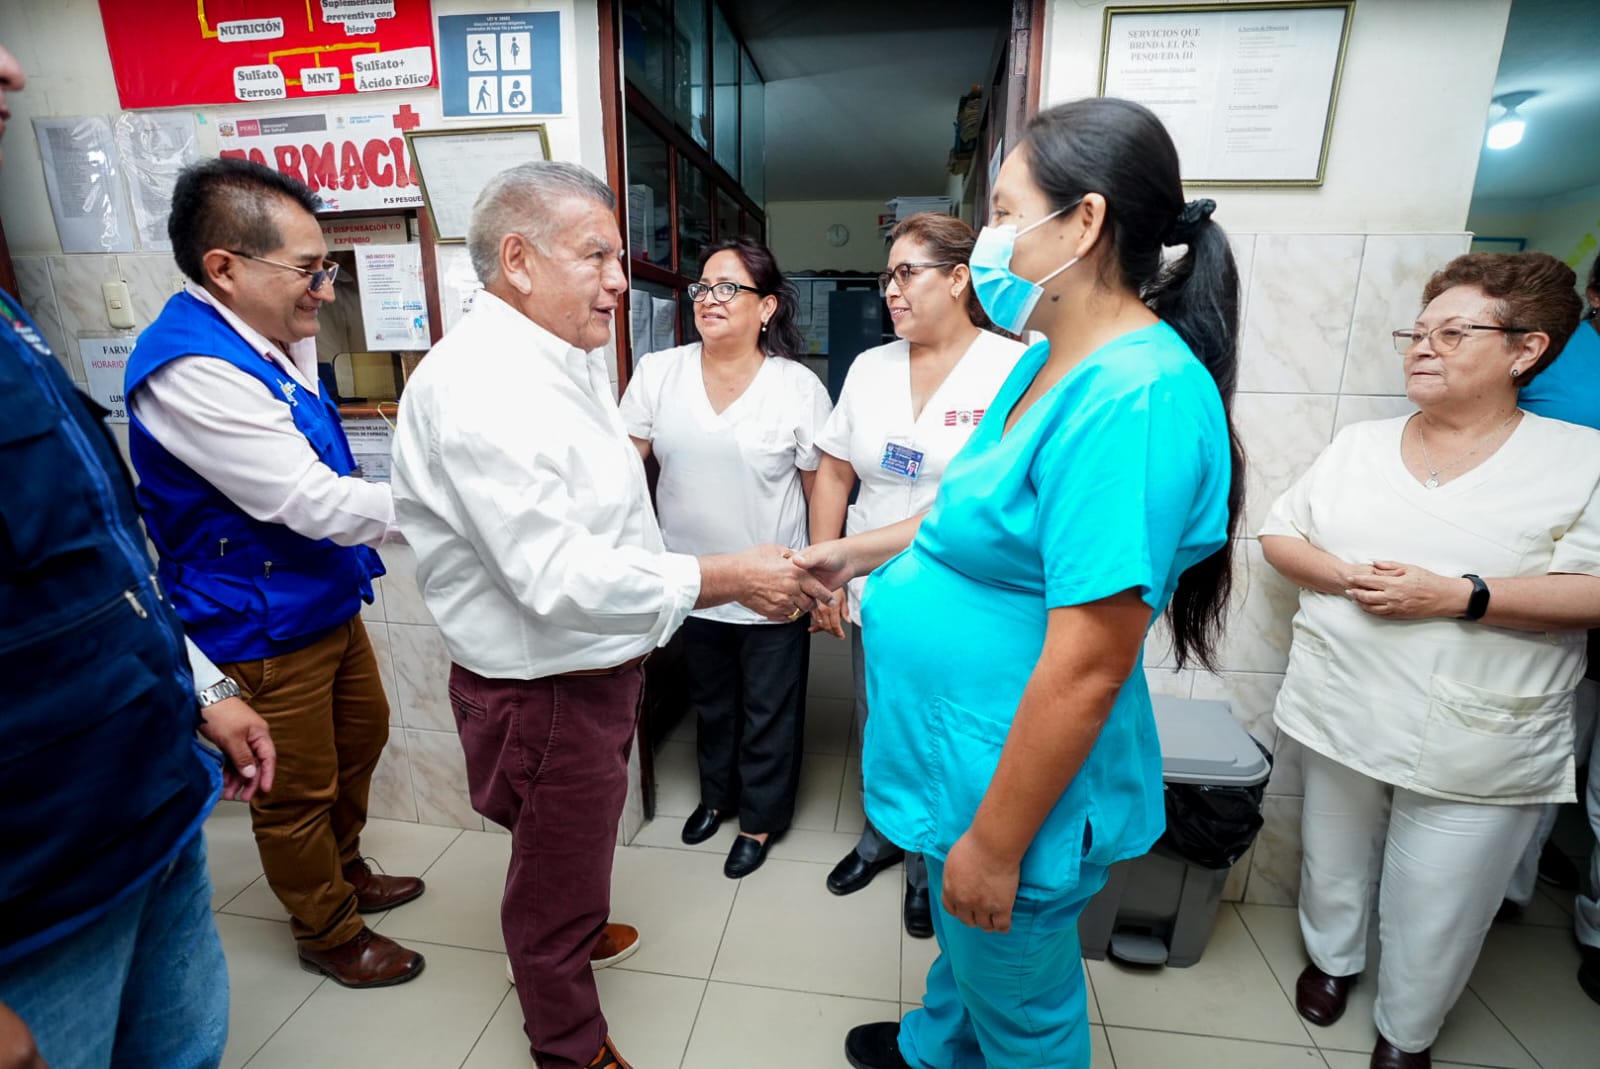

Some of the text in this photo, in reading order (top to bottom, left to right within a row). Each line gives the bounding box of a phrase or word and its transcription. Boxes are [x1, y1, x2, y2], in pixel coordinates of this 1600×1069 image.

[326, 11, 375, 21] preventiva
[220, 21, 281, 36] NUTRICIÓN
[346, 25, 375, 34] hierro
[1128, 28, 1201, 39] SERVICIOS QUE
[1129, 41, 1165, 50] BRINDA
[1167, 40, 1179, 49] EL
[1131, 51, 1193, 61] PESQUEDA III
[355, 59, 405, 73] Sulfato+
[237, 70, 279, 81] Sulfato
[307, 72, 334, 84] MNT
[358, 73, 430, 90] Ácido Fólico
[239, 87, 283, 98] Ferroso
[91, 360, 125, 368] HORARIO
